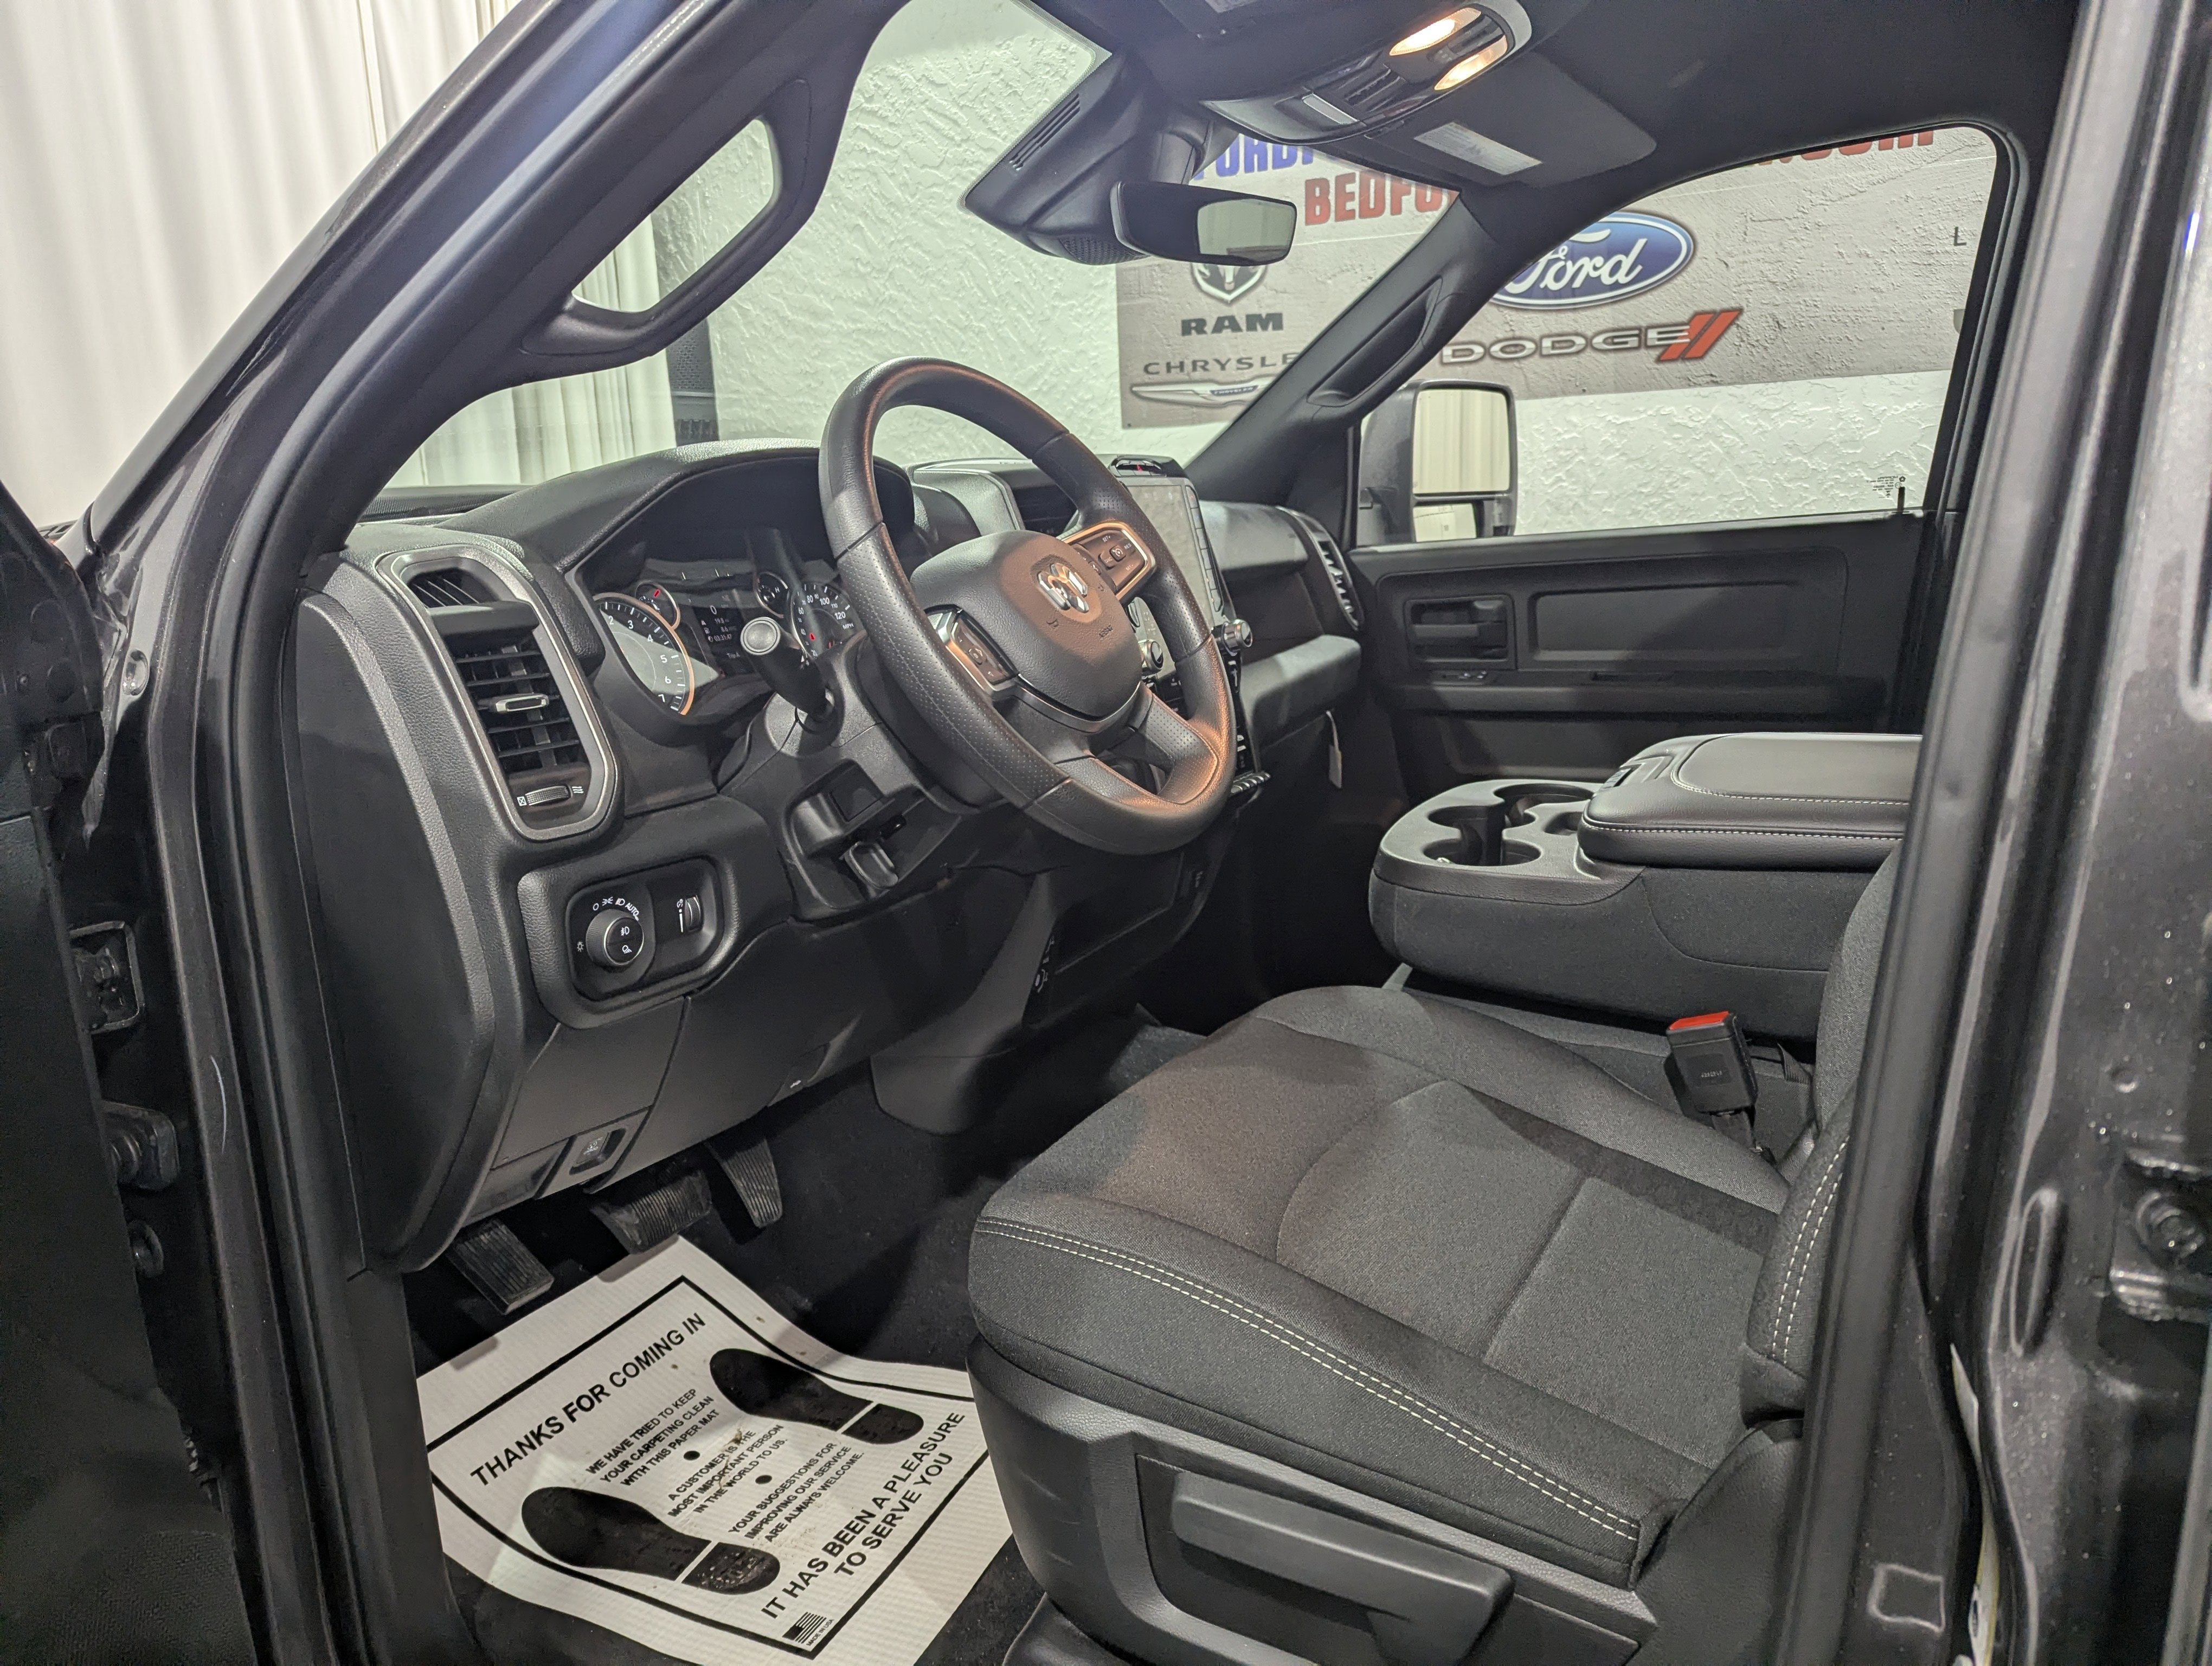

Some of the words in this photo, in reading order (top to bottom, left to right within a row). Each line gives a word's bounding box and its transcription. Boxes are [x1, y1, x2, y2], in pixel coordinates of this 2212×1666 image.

[1504, 228, 1648, 294] Ford
[1181, 312, 1284, 336] RAM
[1442, 325, 1690, 364] DODGE
[608, 616, 614, 625] 2
[627, 620, 634, 629] 3
[807, 595, 813, 604] 80
[819, 597, 830, 606] 100
[834, 611, 846, 620] 120
[647, 634, 653, 643] 4
[660, 654, 667, 663] 5
[658, 694, 666, 703] 7
[665, 676, 672, 684] 6
[625, 902, 639, 917] AUTO
[470, 1415, 565, 1486] THANKS
[562, 1383, 611, 1422] FOR
[609, 1329, 685, 1388] COMING
[682, 1312, 706, 1335] IN
[586, 1459, 608, 1474] WE
[603, 1438, 634, 1462] HAVE
[629, 1418, 661, 1440] TRIED
[658, 1407, 674, 1419] TO
[671, 1389, 697, 1409] KEEP
[600, 1459, 633, 1483] YOUR
[630, 1419, 684, 1460] CARPETING
[682, 1396, 714, 1420] CLEAN
[620, 1465, 650, 1486] WITH
[646, 1448, 671, 1466] THIS
[667, 1425, 702, 1450] PAPER
[698, 1409, 719, 1426] MAT
[667, 1494, 698, 1517] MOST
[696, 1452, 749, 1494] IMPORTANT
[746, 1424, 784, 1453] PERSON
[676, 1453, 730, 1493] CUSTOMER
[736, 1431, 756, 1446] THE
[693, 1504, 709, 1514] IN
[704, 1488, 728, 1503] THE
[723, 1460, 760, 1488] WORLD
[756, 1450, 772, 1460] TO
[769, 1438, 788, 1450] US.
[728, 1510, 761, 1534] YOUR
[756, 1458, 819, 1510] SUGGESTIONS
[815, 1443, 837, 1458] FOR
[744, 1495, 798, 1539] IMPROVING
[795, 1477, 818, 1495] OUR
[814, 1446, 852, 1477] SERVICE
[764, 1522, 788, 1543] ARE
[784, 1491, 822, 1523] ALWAYS
[817, 1452, 865, 1491] WELCOME.
[761, 1597, 786, 1619] IT
[781, 1558, 829, 1599] HAS
[821, 1509, 877, 1558] BEEN
[872, 1495, 891, 1510] A
[883, 1412, 965, 1493] PLEASURE
[833, 1552, 867, 1576] TO
[861, 1489, 923, 1549] SERVE
[913, 1452, 954, 1486] YOU
[806, 1633, 821, 1646] MADE
[824, 1619, 835, 1628] USA
